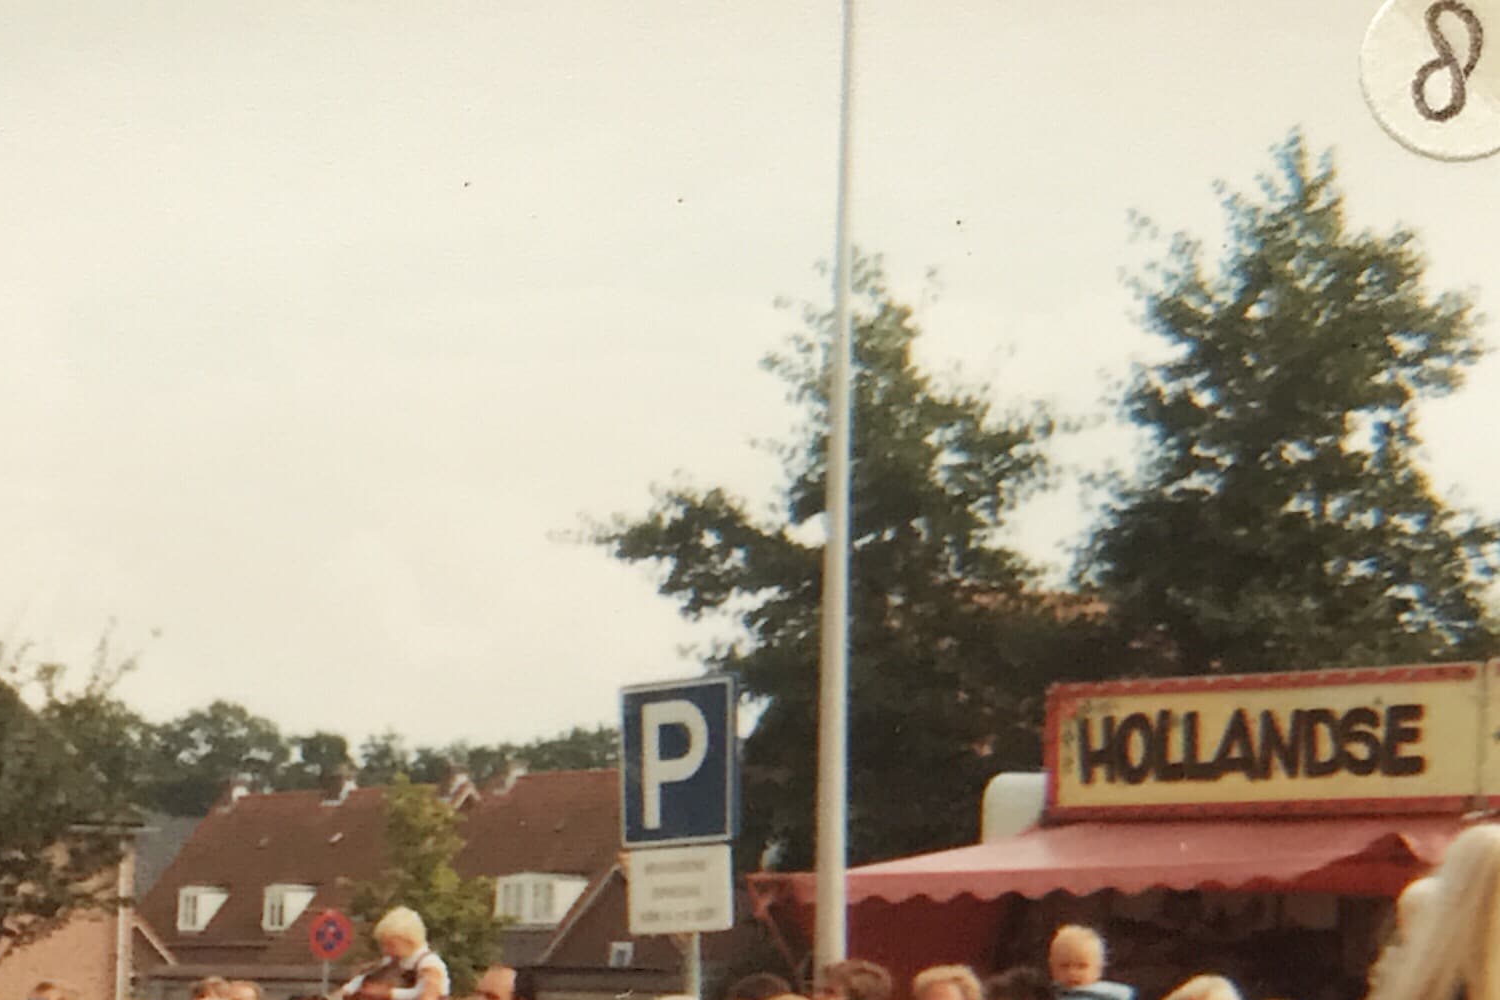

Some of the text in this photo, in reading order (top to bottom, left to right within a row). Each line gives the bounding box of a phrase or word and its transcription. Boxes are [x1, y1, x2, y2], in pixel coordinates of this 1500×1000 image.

[1411, 0, 1484, 123] 8
[642, 698, 709, 830] P
[1077, 702, 1428, 786] HOLLANDSE
